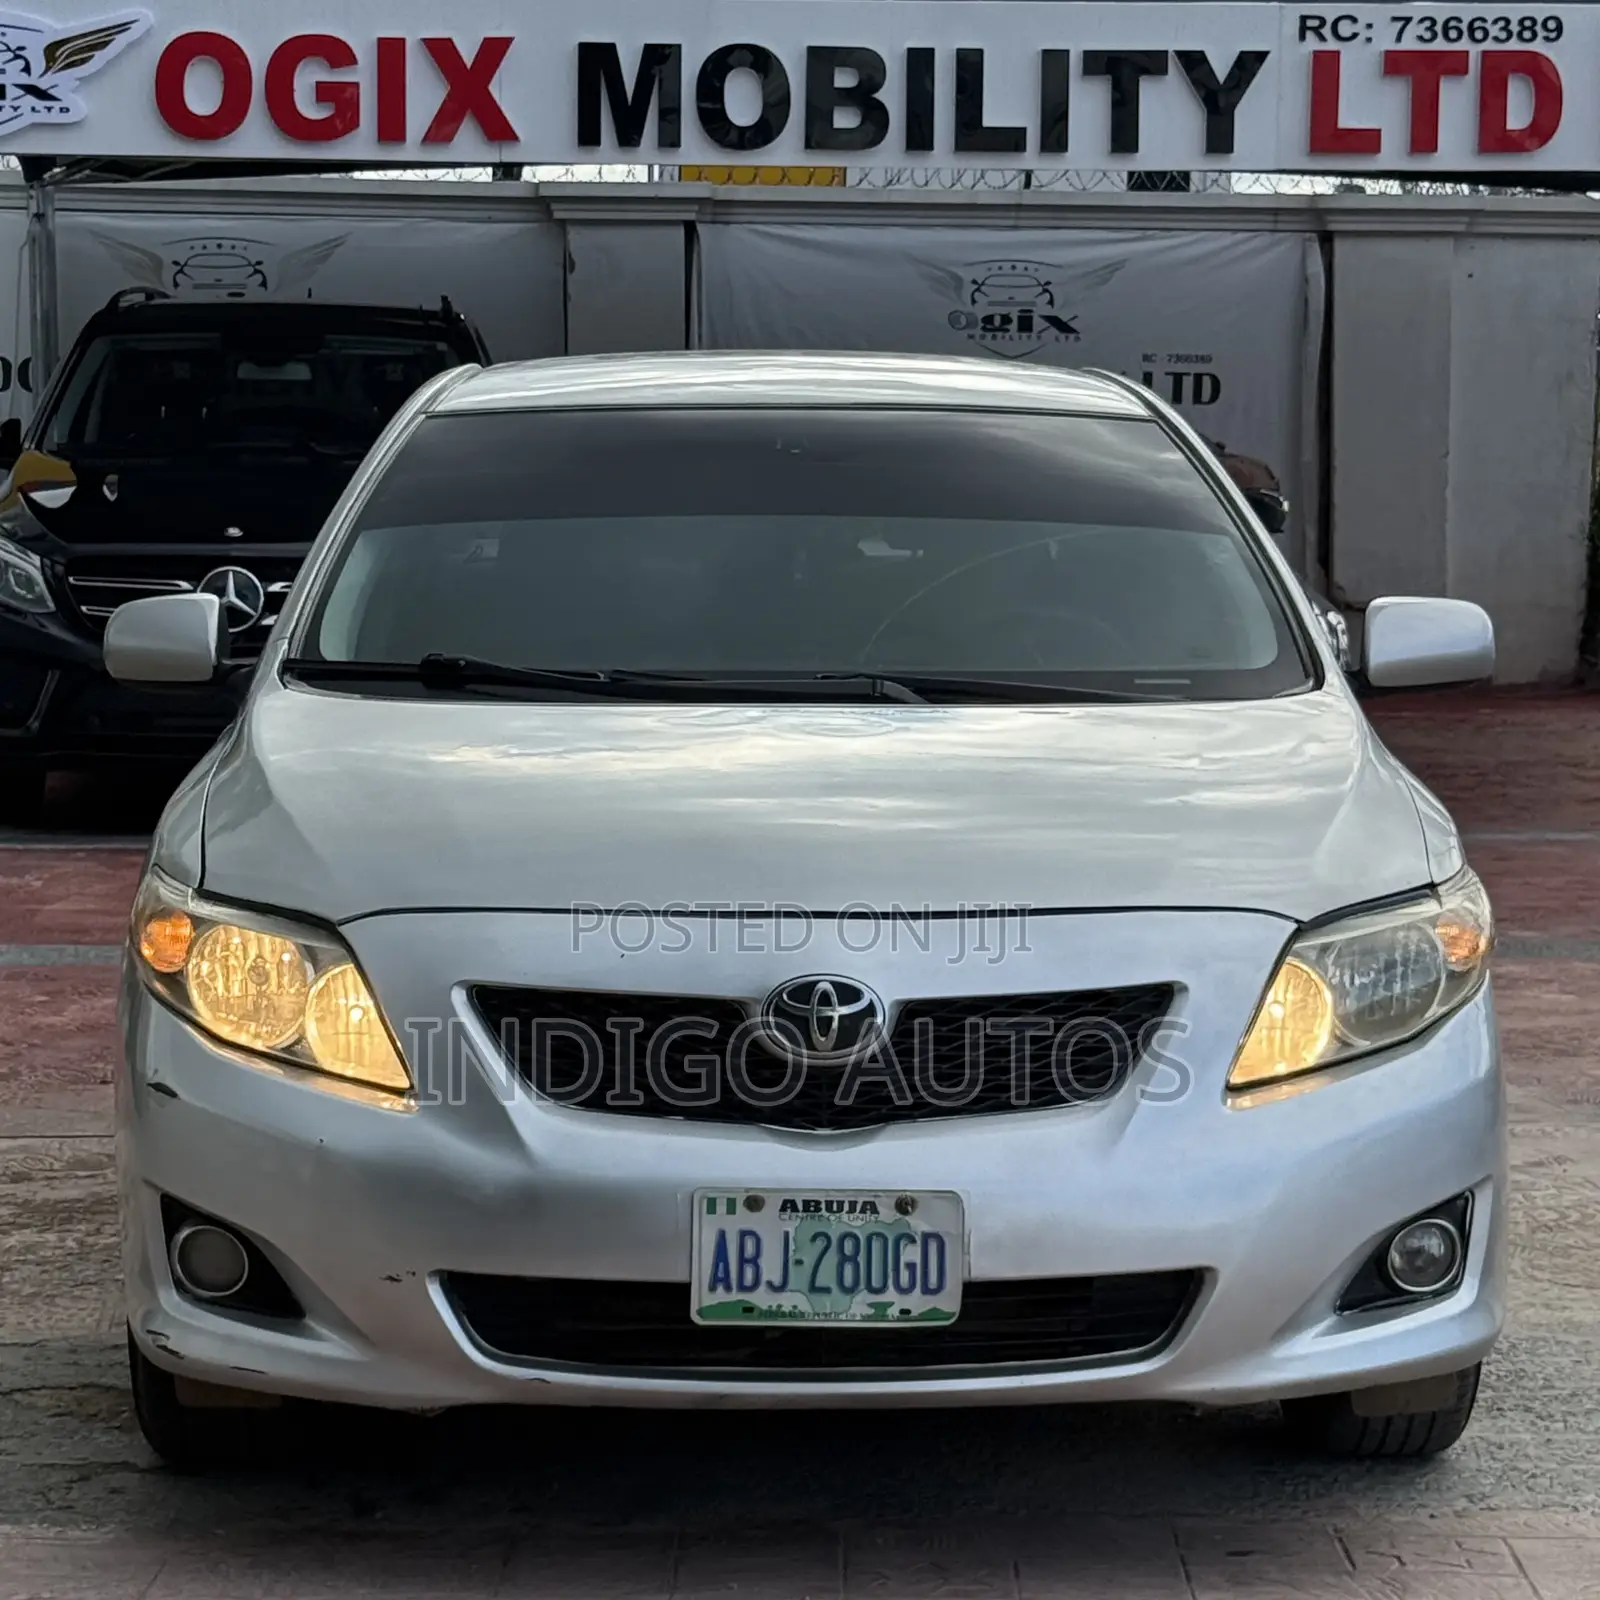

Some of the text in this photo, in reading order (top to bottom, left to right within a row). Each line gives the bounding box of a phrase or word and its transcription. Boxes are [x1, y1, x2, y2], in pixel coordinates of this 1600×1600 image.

[1299, 14, 1564, 44] RC: 7366389
[155, 31, 1563, 154] OGIX MOBILITY LTD
[30, 106, 71, 114] LTD
[778, 1198, 880, 1215] ABUJA
[708, 1228, 946, 1296] ABJ-280GD
